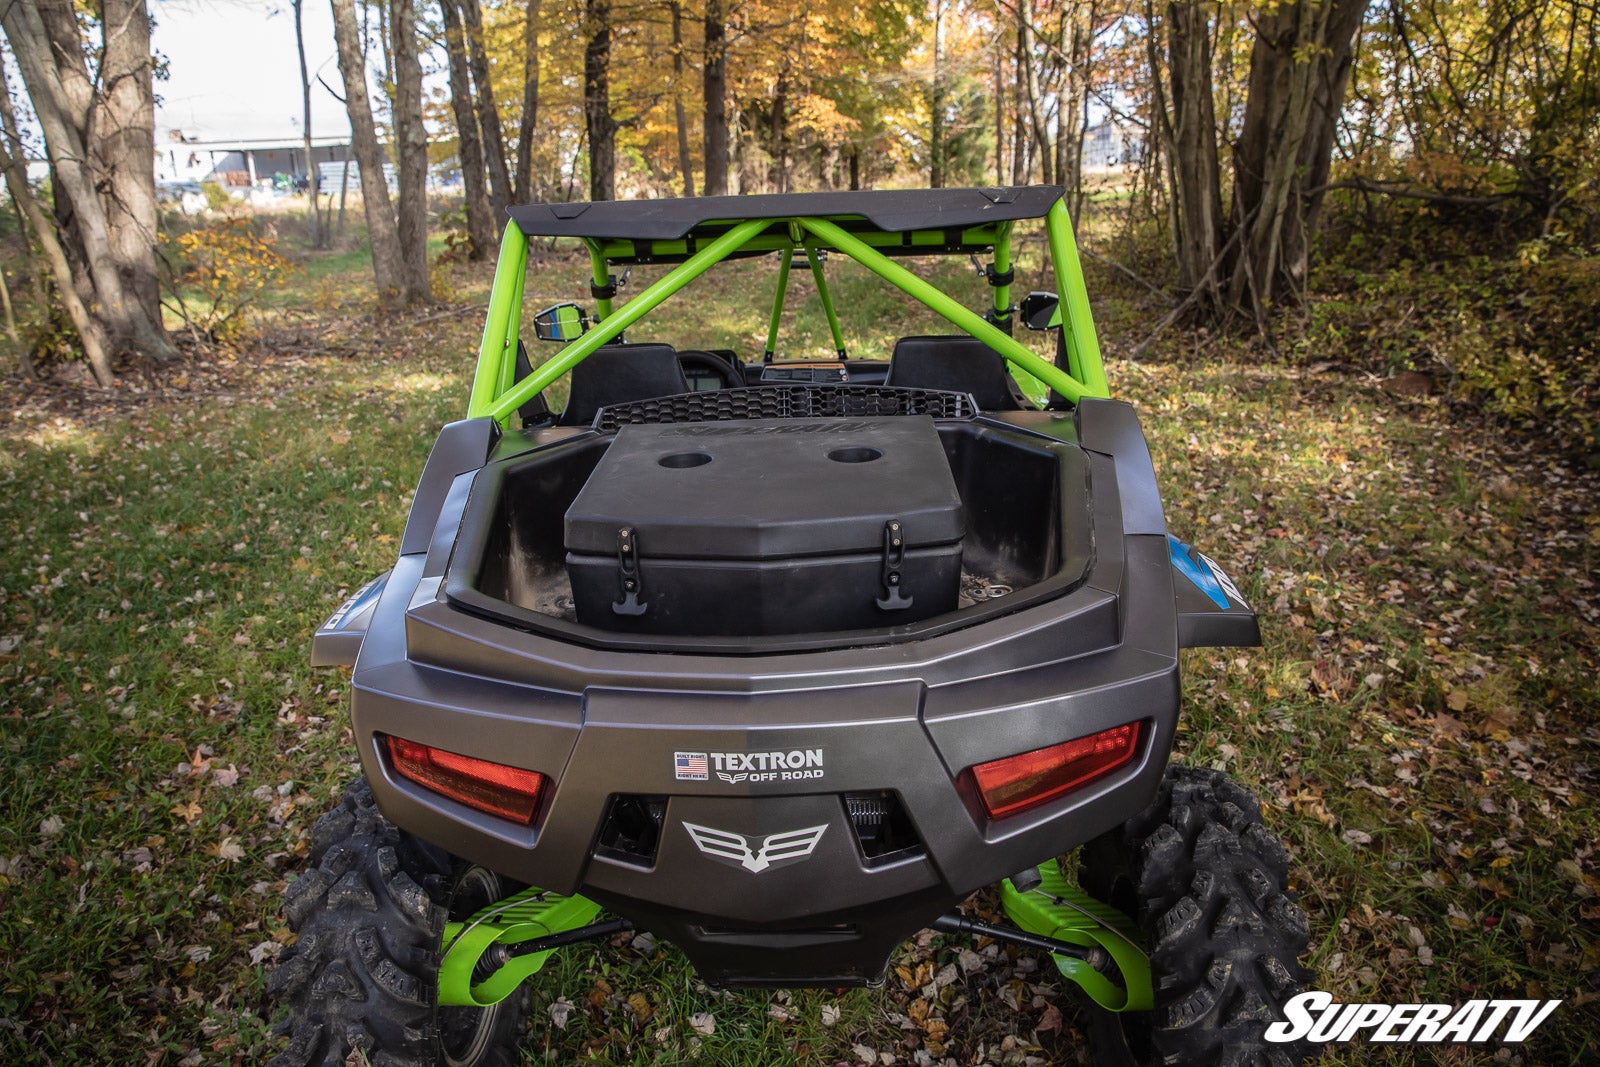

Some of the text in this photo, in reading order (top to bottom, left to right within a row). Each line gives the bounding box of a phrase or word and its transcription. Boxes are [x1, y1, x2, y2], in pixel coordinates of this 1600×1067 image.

[710, 749, 824, 771] TEXTRON
[750, 769, 824, 782] OFF ROAD
